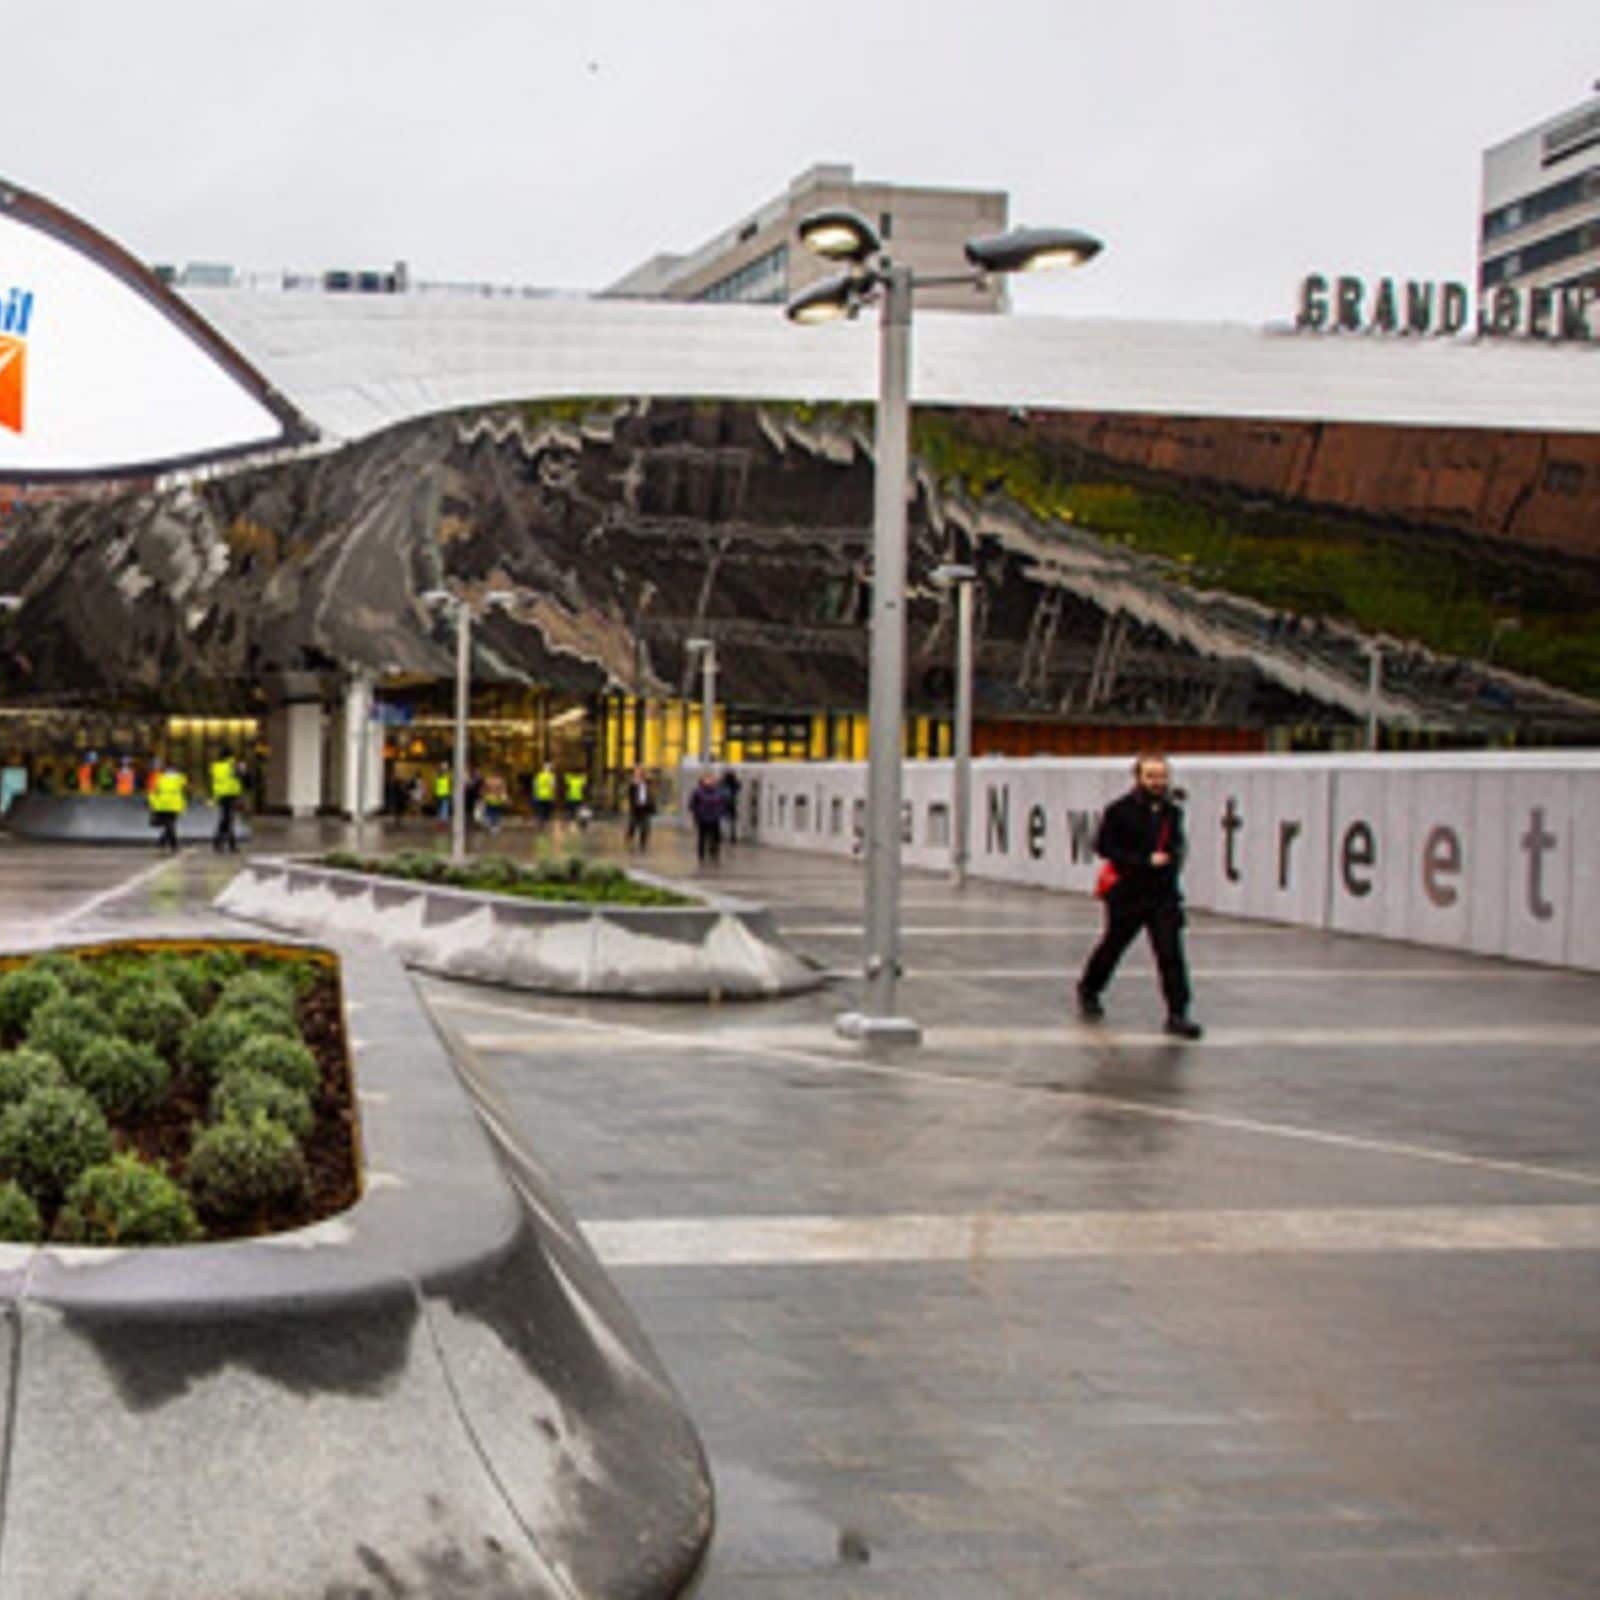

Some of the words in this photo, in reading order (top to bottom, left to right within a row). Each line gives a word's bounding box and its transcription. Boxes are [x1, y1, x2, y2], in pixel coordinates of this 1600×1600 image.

[1299, 273, 1467, 335] GRAND
[750, 777, 949, 855] Birmingam
[1221, 796, 1557, 920] treet
